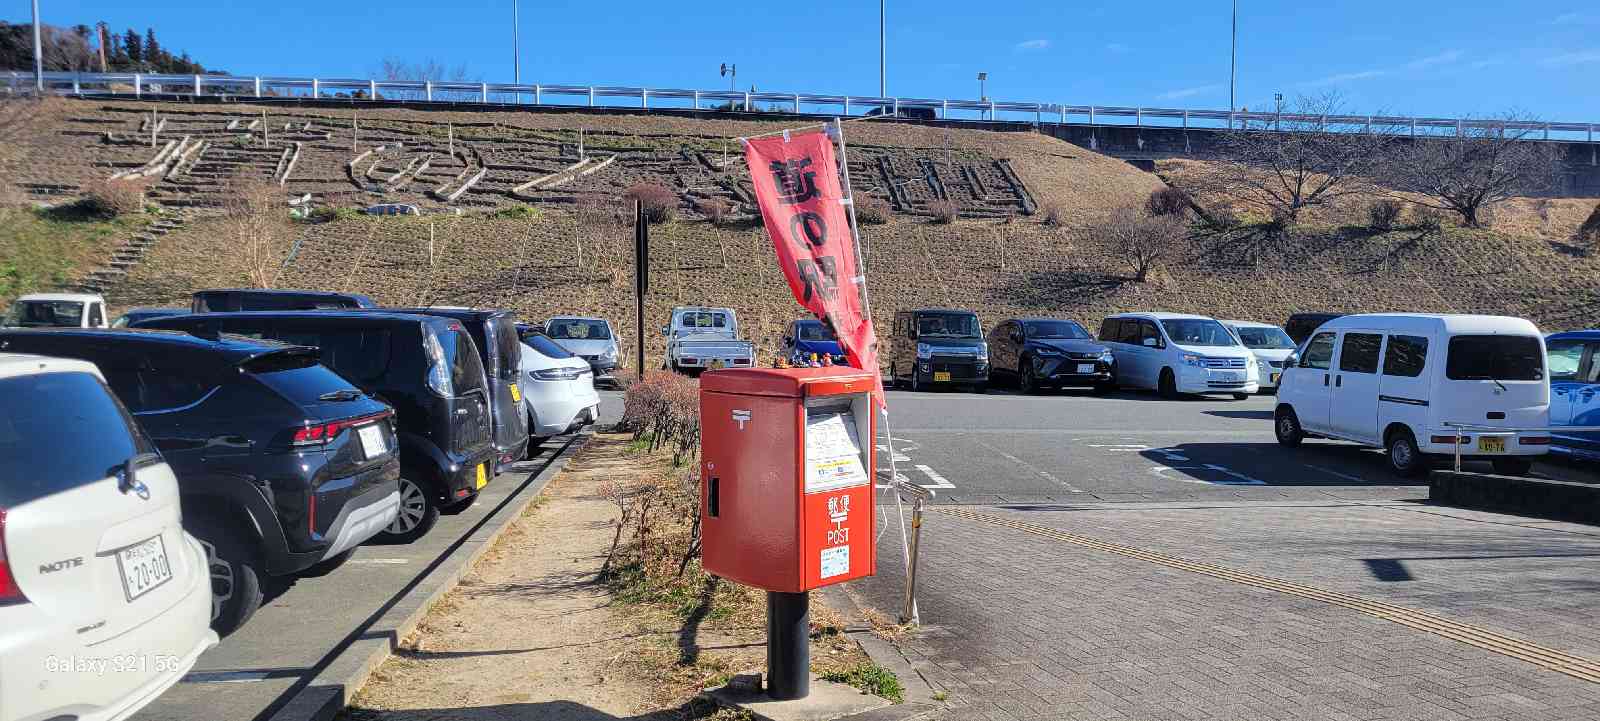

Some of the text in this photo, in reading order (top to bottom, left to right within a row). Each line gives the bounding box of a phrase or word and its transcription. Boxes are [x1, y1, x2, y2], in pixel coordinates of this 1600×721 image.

[828, 495, 851, 514] 郵便
[827, 528, 849, 545] POST
[39, 556, 84, 574] NOTE
